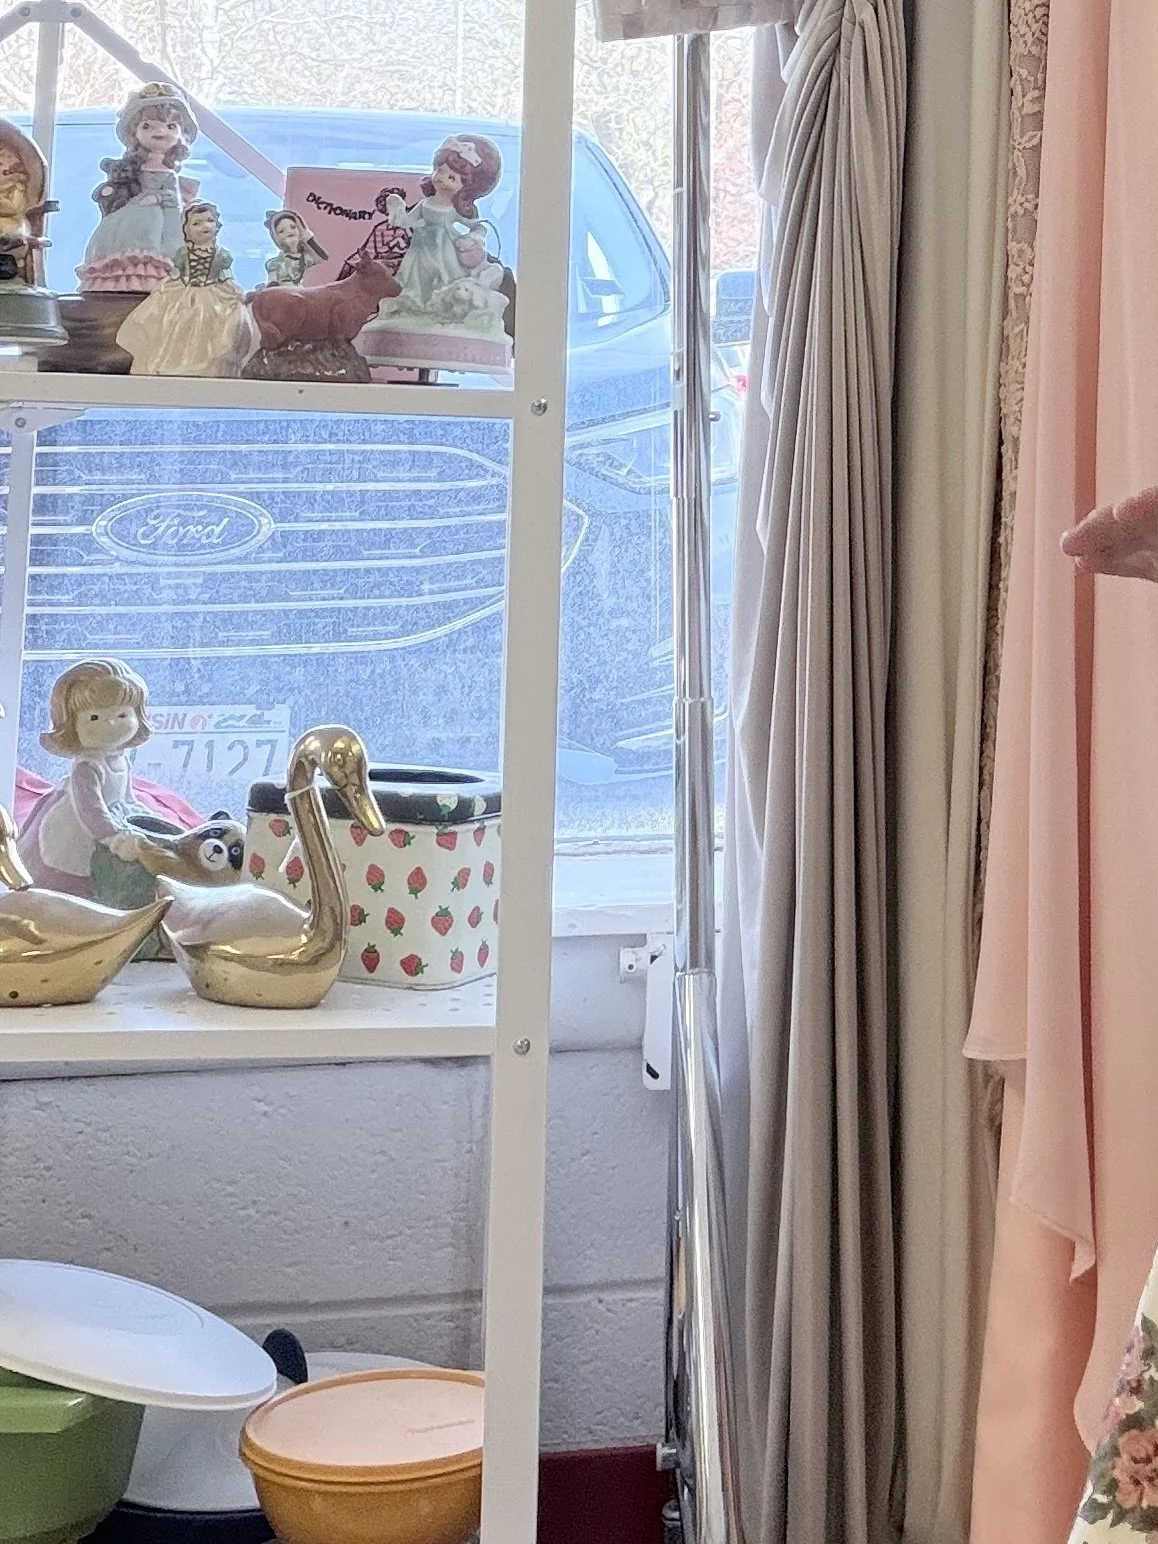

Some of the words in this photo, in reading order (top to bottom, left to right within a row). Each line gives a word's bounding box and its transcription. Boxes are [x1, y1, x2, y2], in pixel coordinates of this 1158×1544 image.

[305, 192, 376, 221] DICTIONARY
[136, 508, 230, 545] Ford
[149, 713, 187, 731] SIN
